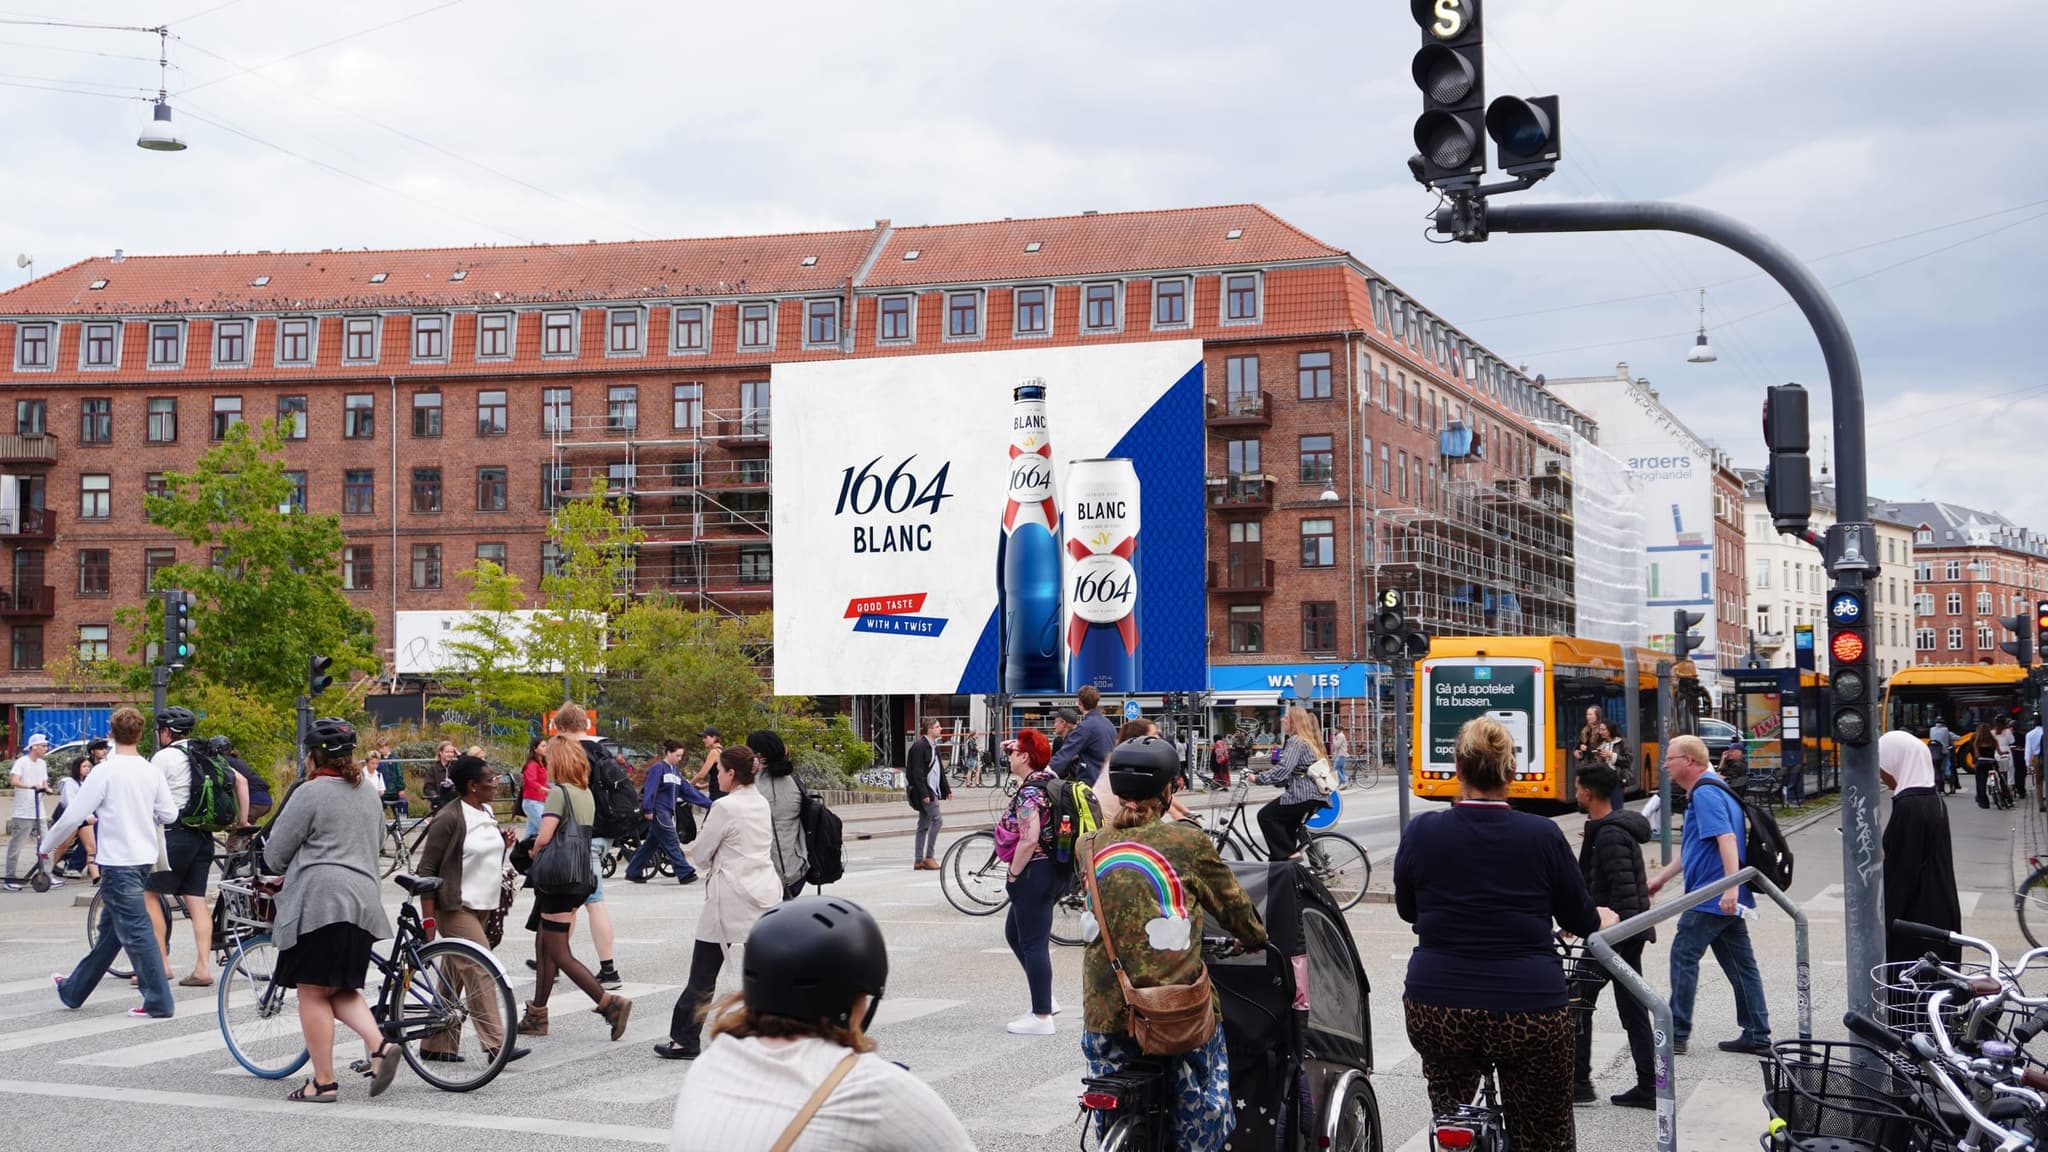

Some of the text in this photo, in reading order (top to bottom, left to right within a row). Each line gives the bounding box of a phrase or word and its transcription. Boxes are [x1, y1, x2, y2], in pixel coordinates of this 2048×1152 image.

[1433, 0, 1461, 37] S
[1013, 415, 1047, 430] BLANC
[834, 453, 955, 516] 1664
[1008, 463, 1052, 492] 1664
[1077, 501, 1126, 520] BLANC
[853, 523, 933, 554] BLANC
[1073, 568, 1133, 604] 1664
[856, 598, 914, 613] GOOD TASTE
[1384, 591, 1397, 608] S
[866, 618, 890, 630] WITH
[893, 620, 900, 631] A
[1267, 673, 1340, 688] WAES
[1435, 682, 1515, 696] Gå på apoteket
[1435, 695, 1493, 706] fra bussen.
[1435, 746, 1456, 756] apo
